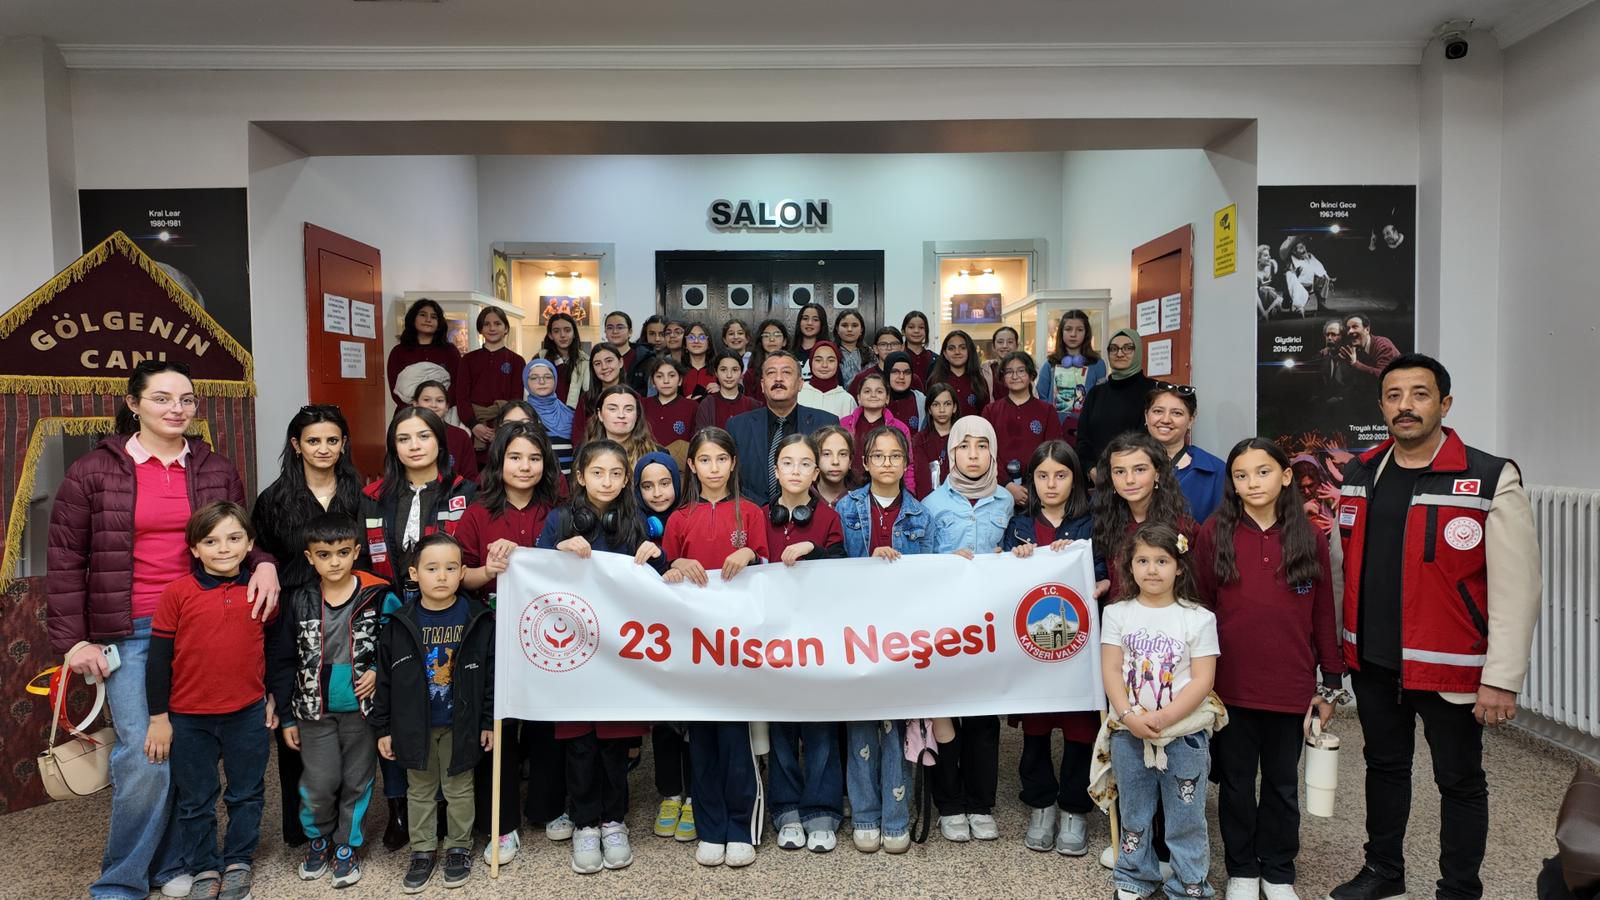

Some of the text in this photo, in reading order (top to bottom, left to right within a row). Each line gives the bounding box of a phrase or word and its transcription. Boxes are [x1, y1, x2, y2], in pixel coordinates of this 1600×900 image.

[709, 200, 830, 228] SALON
[30, 311, 211, 357] GÖLGENİN
[1041, 587, 1059, 595] T.C.
[422, 625, 464, 644] TMAN
[618, 620, 672, 662] 23
[691, 626, 825, 668] Nisan
[843, 612, 997, 669] Neşesi
[1020, 634, 1054, 660] KAYSERİ
